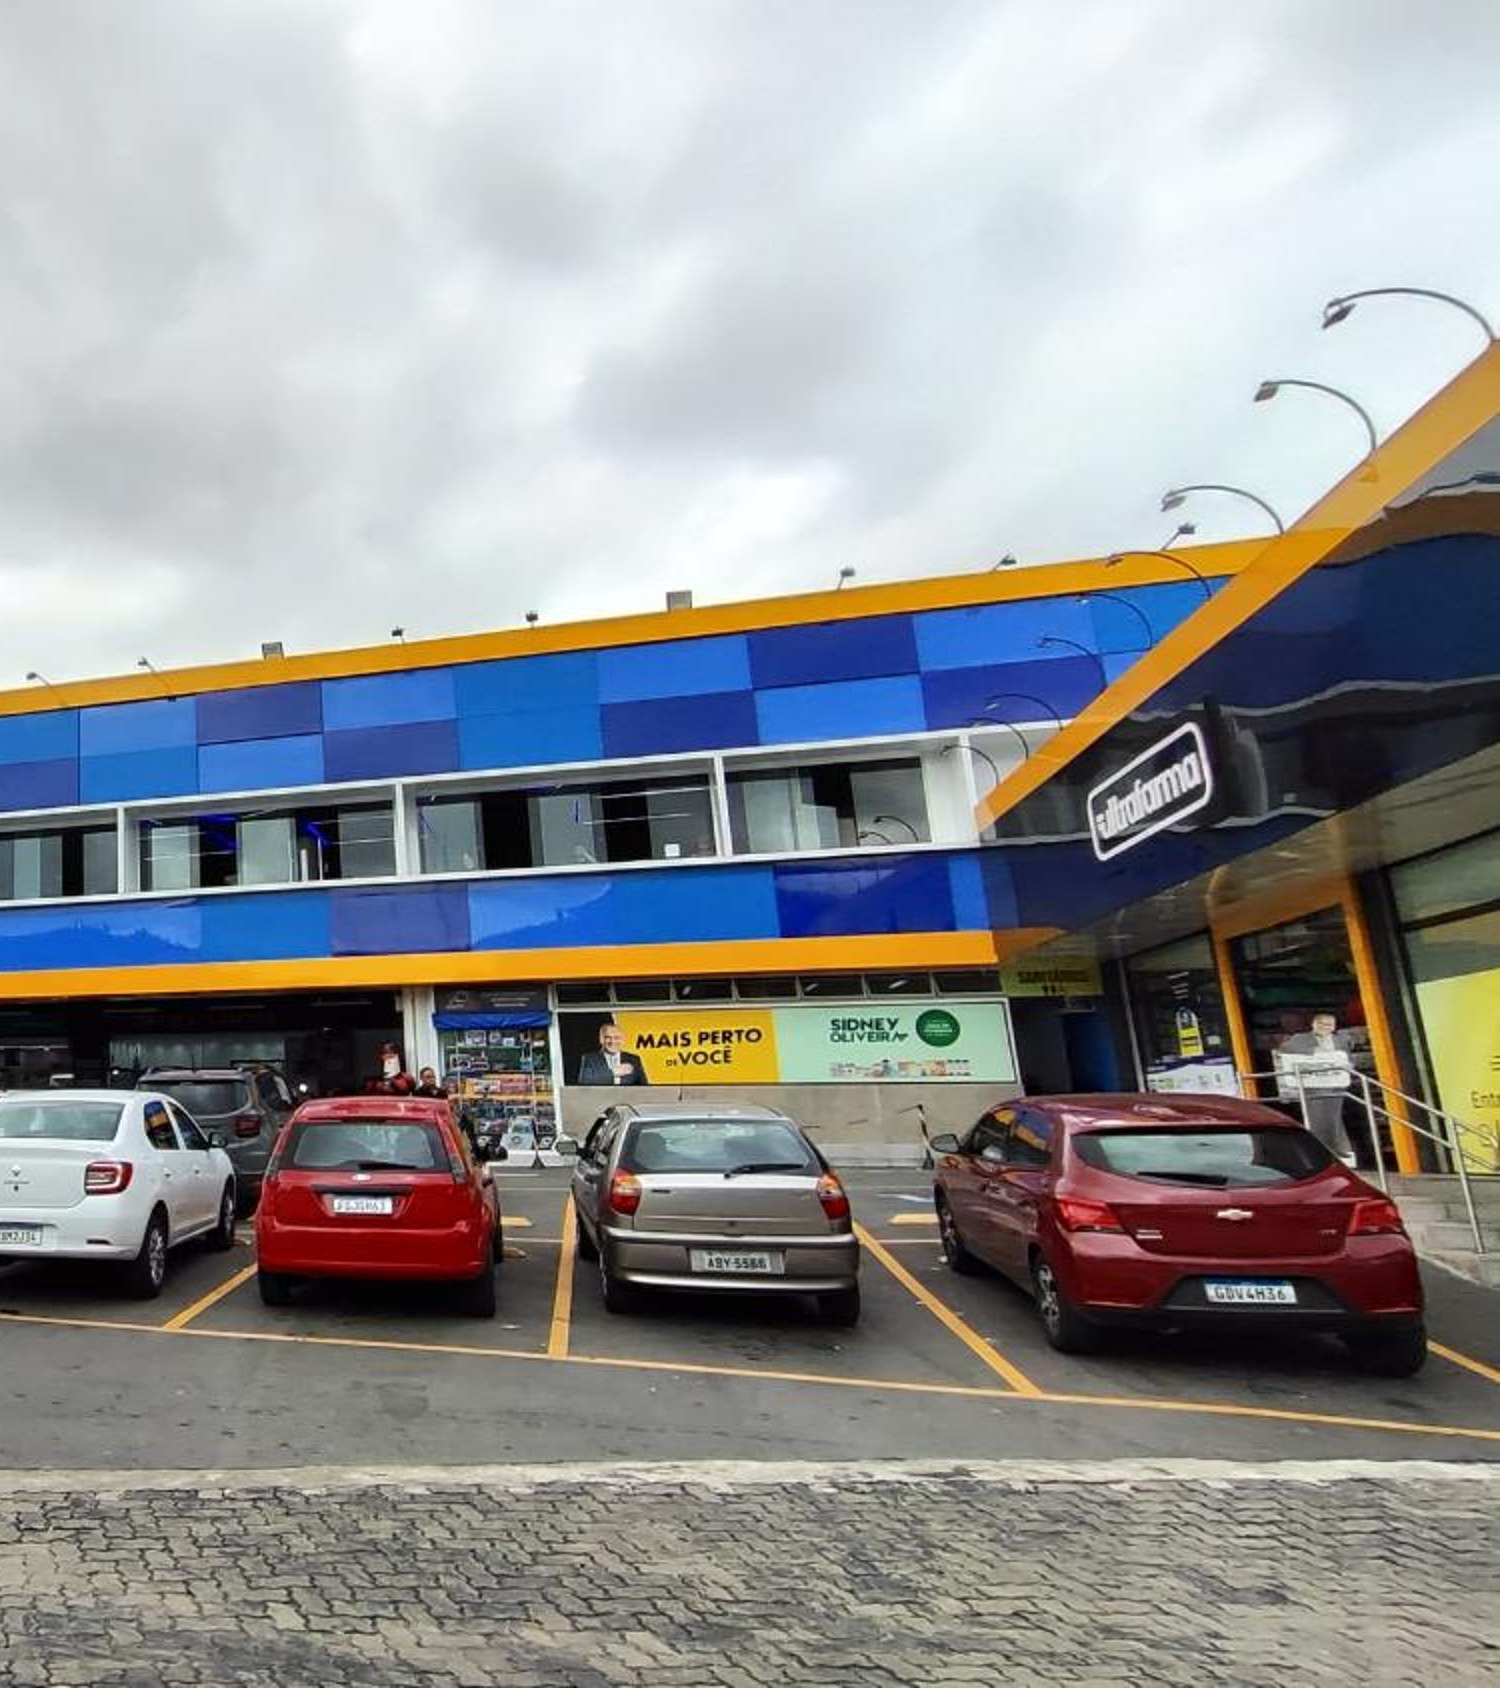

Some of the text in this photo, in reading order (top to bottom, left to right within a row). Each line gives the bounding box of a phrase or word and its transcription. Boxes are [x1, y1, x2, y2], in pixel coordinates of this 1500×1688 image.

[1096, 752, 1202, 839] ultrafarma
[830, 1018, 899, 1031] SIDNEY
[636, 1028, 763, 1049] MAIS PERTO
[678, 1046, 733, 1066] VOCÊ
